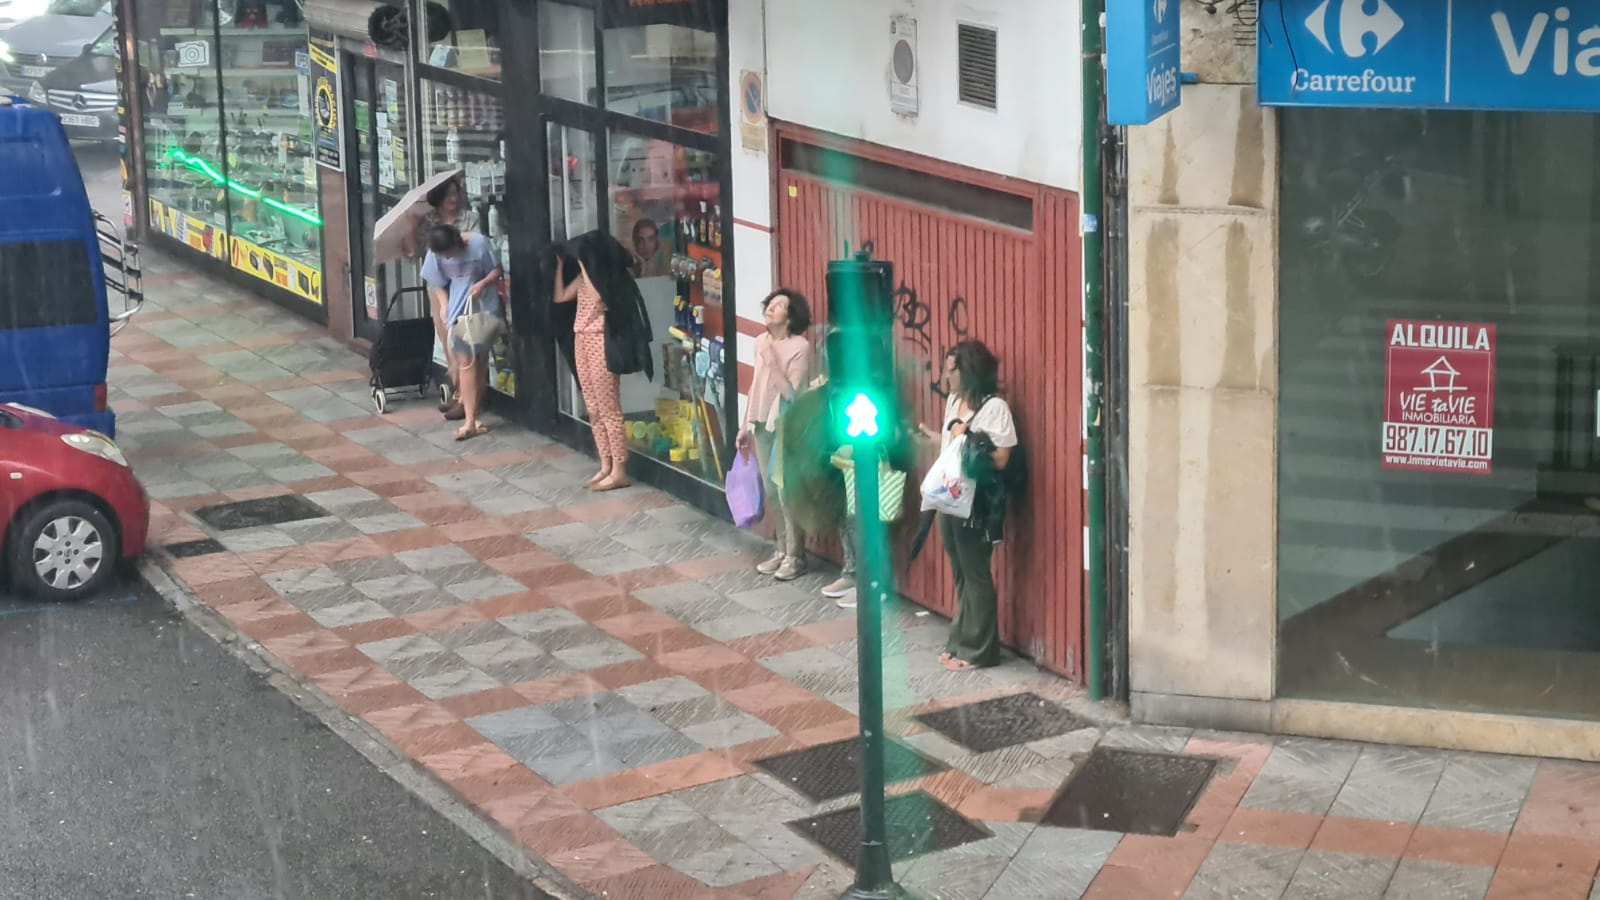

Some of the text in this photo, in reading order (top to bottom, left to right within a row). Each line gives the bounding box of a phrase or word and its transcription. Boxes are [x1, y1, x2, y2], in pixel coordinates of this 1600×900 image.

[1147, 64, 1177, 107] Viajes
[1291, 69, 1416, 94] Carrefour
[1391, 323, 1490, 350] ALQUILA
[1400, 392, 1427, 412] VIE
[1402, 411, 1476, 425] INMOBILIARIA
[1386, 425, 1488, 457] 987.17.67.10
